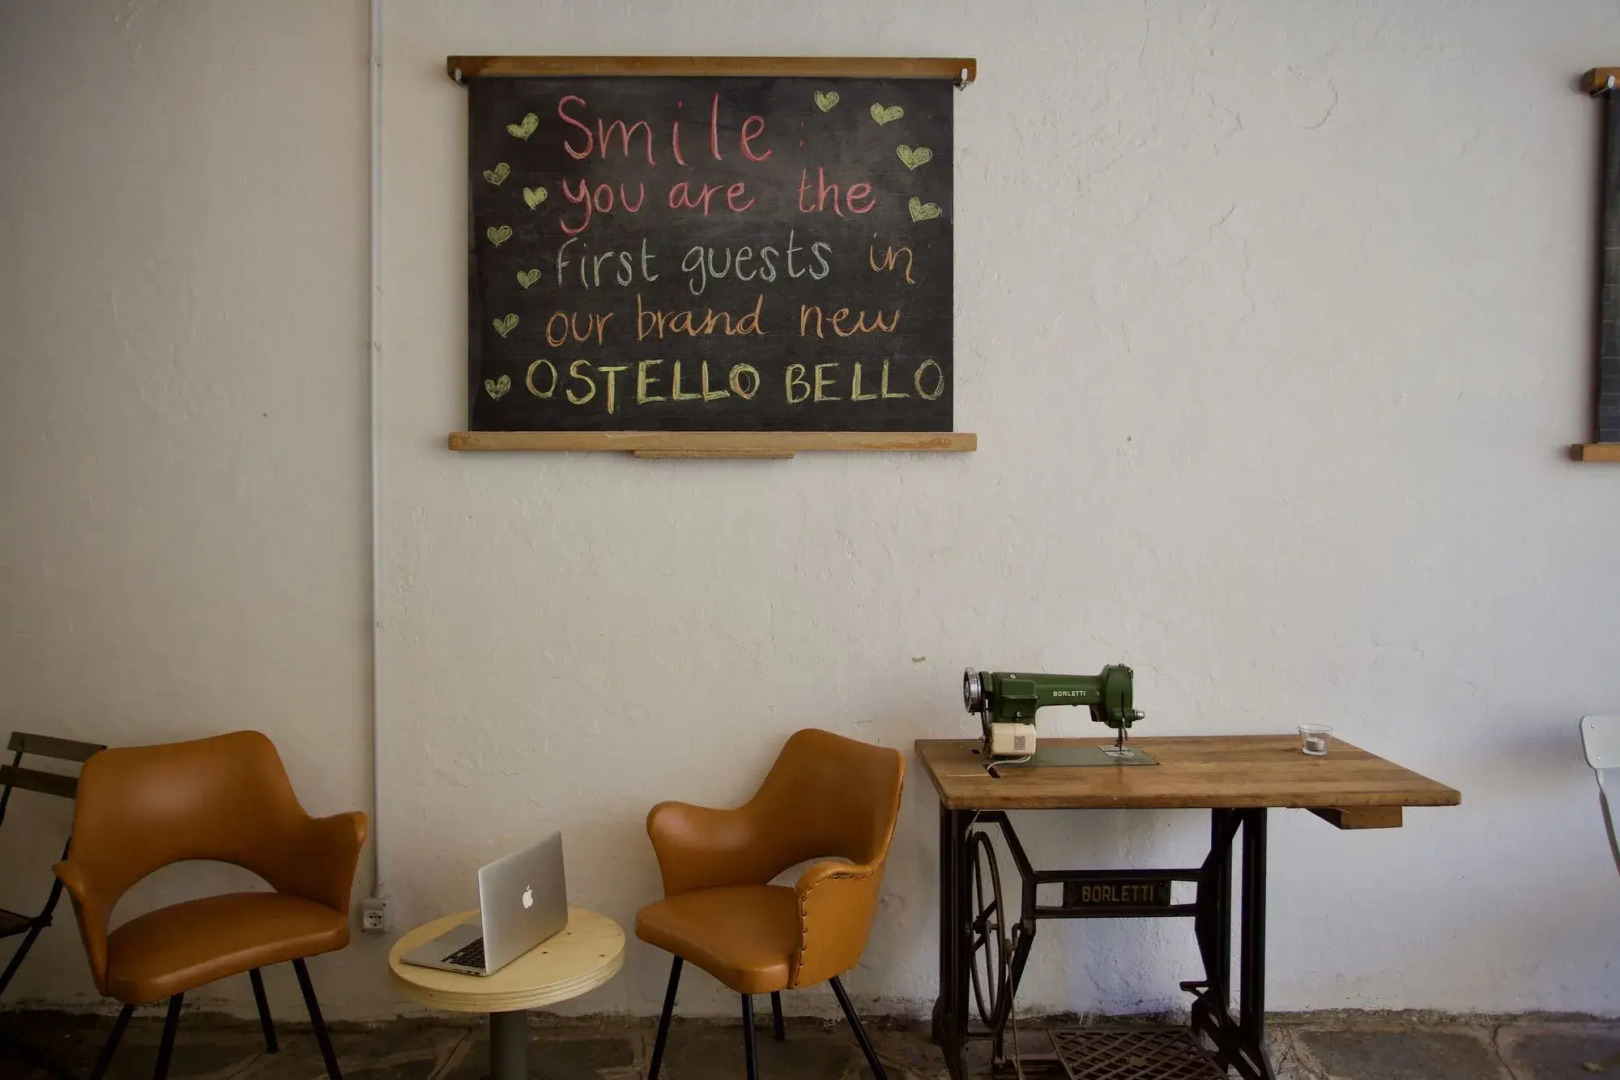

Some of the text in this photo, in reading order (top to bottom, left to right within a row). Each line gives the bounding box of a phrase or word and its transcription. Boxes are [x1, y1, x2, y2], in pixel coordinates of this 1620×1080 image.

[560, 167, 877, 235] you are the
[557, 229, 916, 295] first guests in
[545, 293, 902, 347] our brand new
[526, 358, 945, 414] OSTELLO BELLO
[1081, 885, 1154, 903] BORLETTI
